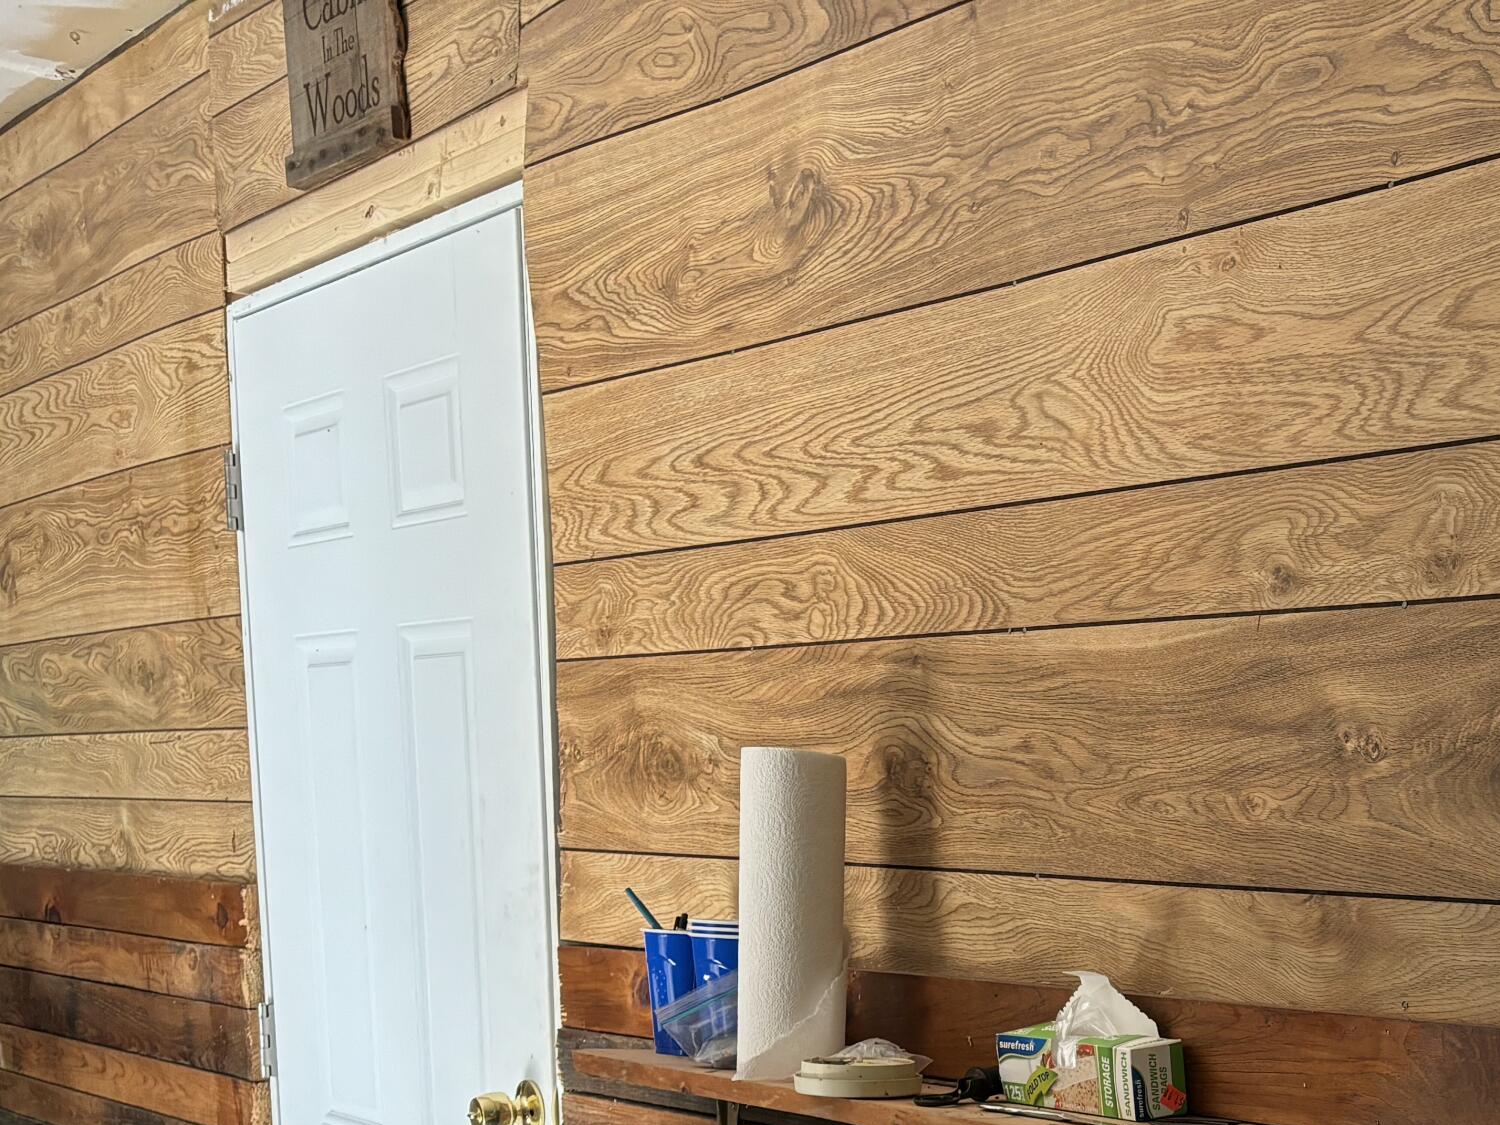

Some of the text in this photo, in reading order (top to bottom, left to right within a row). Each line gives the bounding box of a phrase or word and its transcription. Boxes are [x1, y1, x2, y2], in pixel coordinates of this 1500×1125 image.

[321, 27, 355, 64] In The
[303, 55, 380, 136] Woods
[999, 1039, 1035, 1052] surefresh
[1102, 1056, 1114, 1108] STORAGE
[1121, 1052, 1132, 1117] SANDWICH
[1151, 1053, 1162, 1111] SANDWICH
